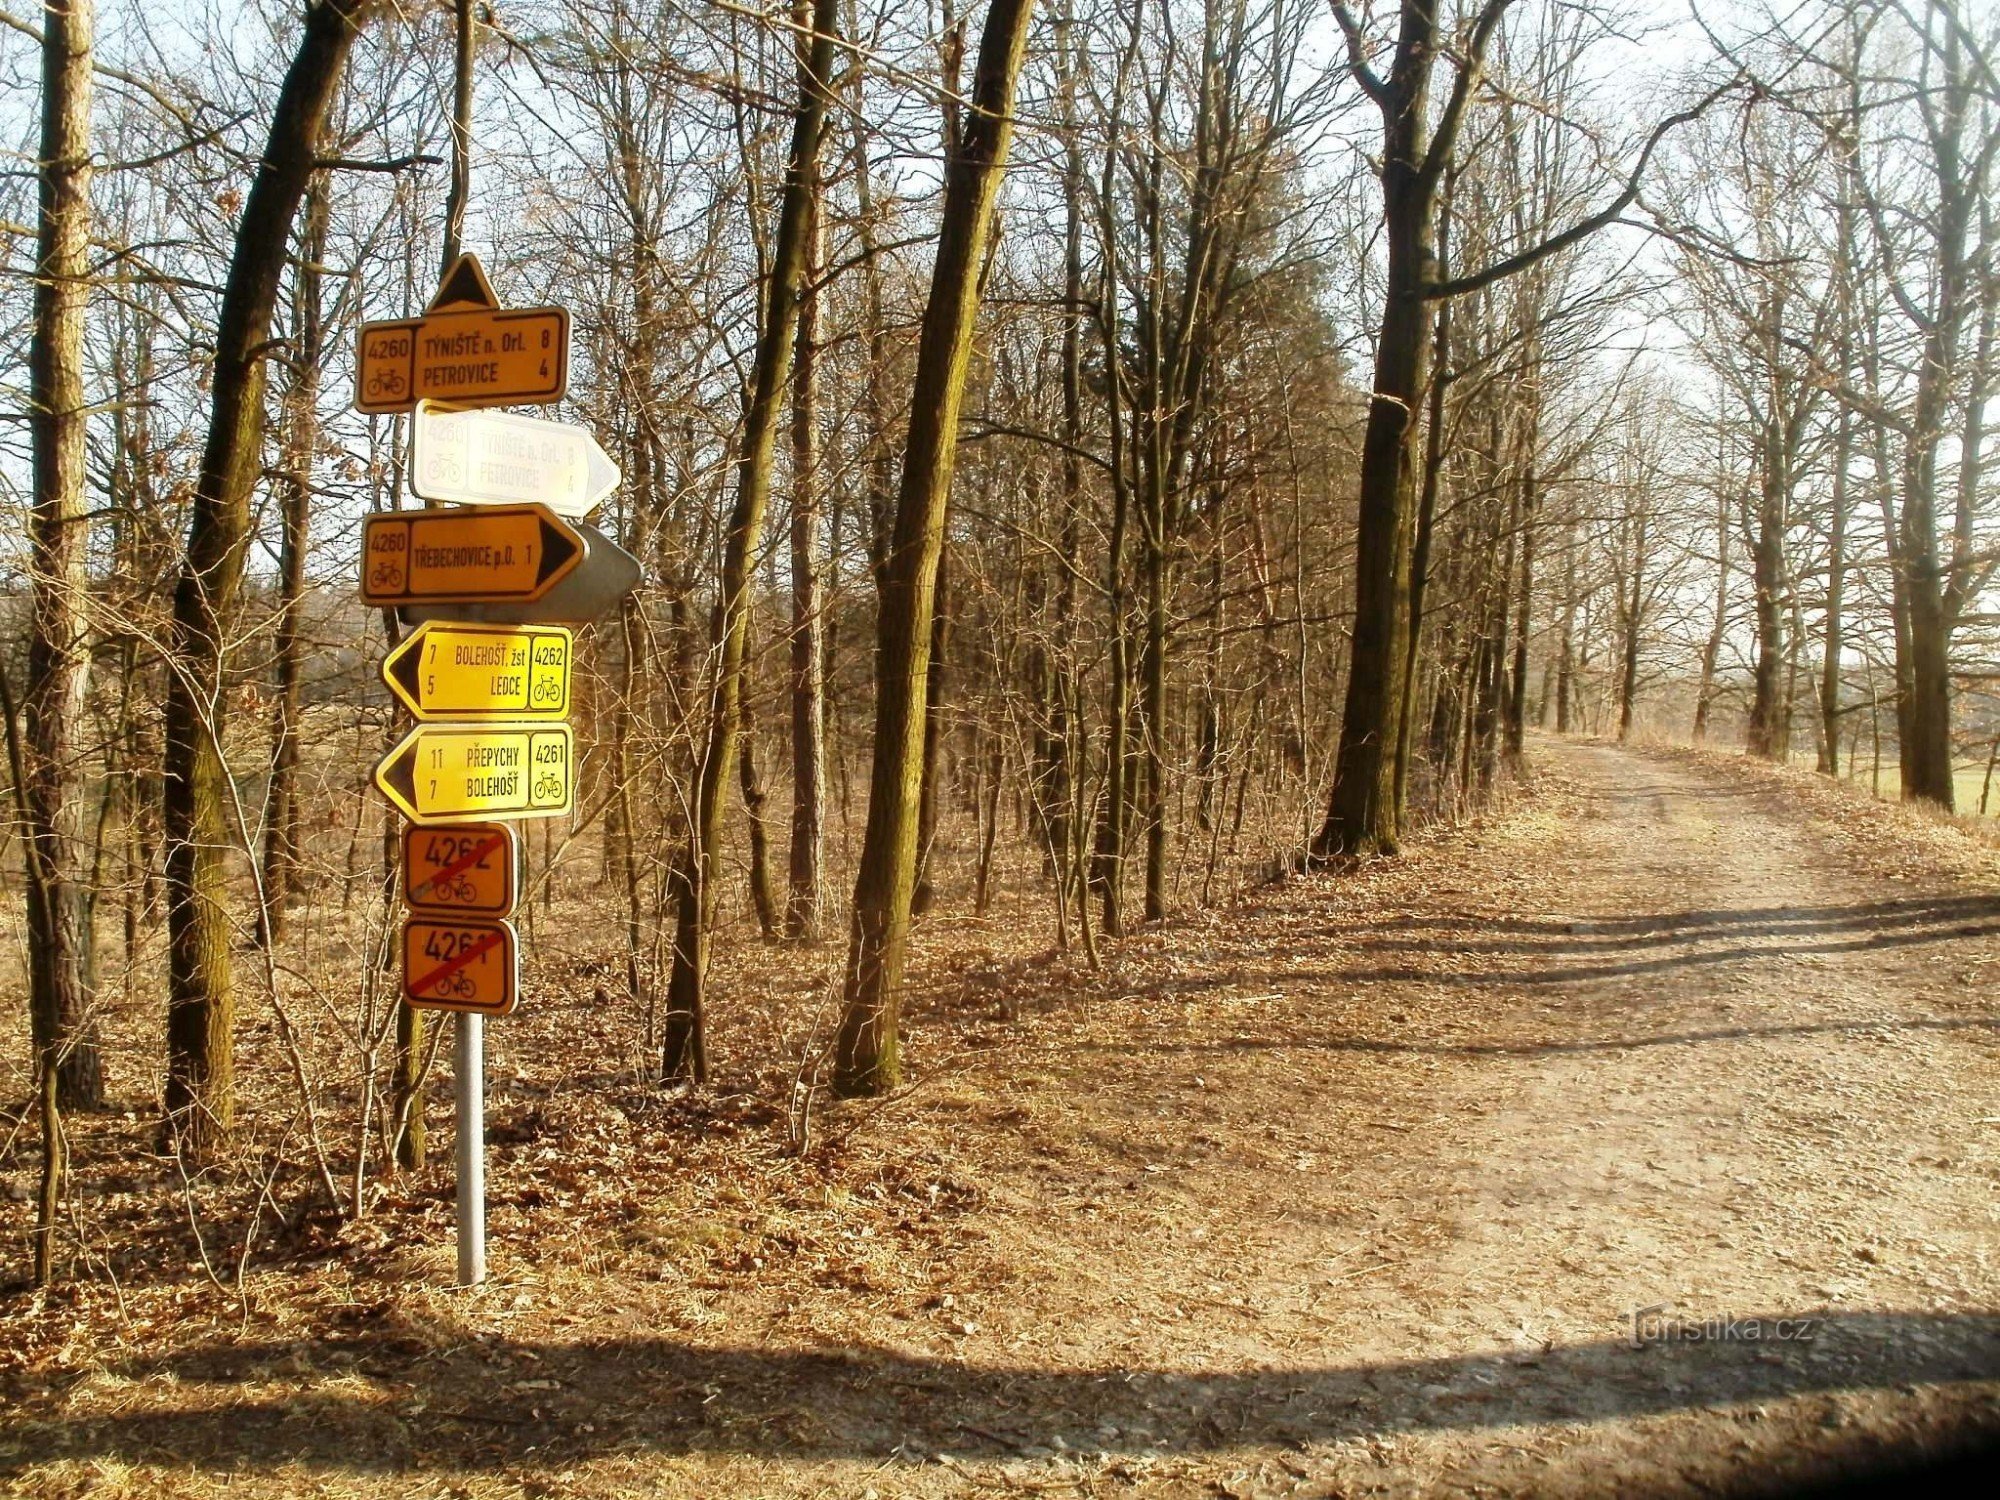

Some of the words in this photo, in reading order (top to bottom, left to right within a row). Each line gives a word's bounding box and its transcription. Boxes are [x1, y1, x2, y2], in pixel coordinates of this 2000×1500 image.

[368, 337, 410, 361] 4260
[424, 330, 480, 359] TÝNIŠTĚ
[484, 340, 496, 354] n.
[501, 332, 526, 353] Orl.
[540, 328, 550, 349] 8
[423, 362, 499, 387] PETROVICE
[539, 358, 548, 378] 4
[428, 420, 464, 444] 4260
[480, 462, 540, 489] PETROVICE
[371, 532, 405, 553] 4260
[414, 544, 491, 569] TŘEBECHOVICE
[525, 545, 532, 564] 1
[429, 644, 437, 665] 7
[511, 650, 525, 667] žst
[534, 646, 563, 666] 4262
[427, 675, 435, 696] 5
[490, 676, 521, 696] LEDCE
[431, 748, 443, 769] 11
[467, 742, 519, 768] PŘEPYCHY
[535, 744, 564, 764] 4261
[430, 779, 437, 800] 7
[467, 771, 519, 798] BOLEHOŠŤ
[425, 835, 491, 869] 4262
[425, 930, 488, 965] 4261
